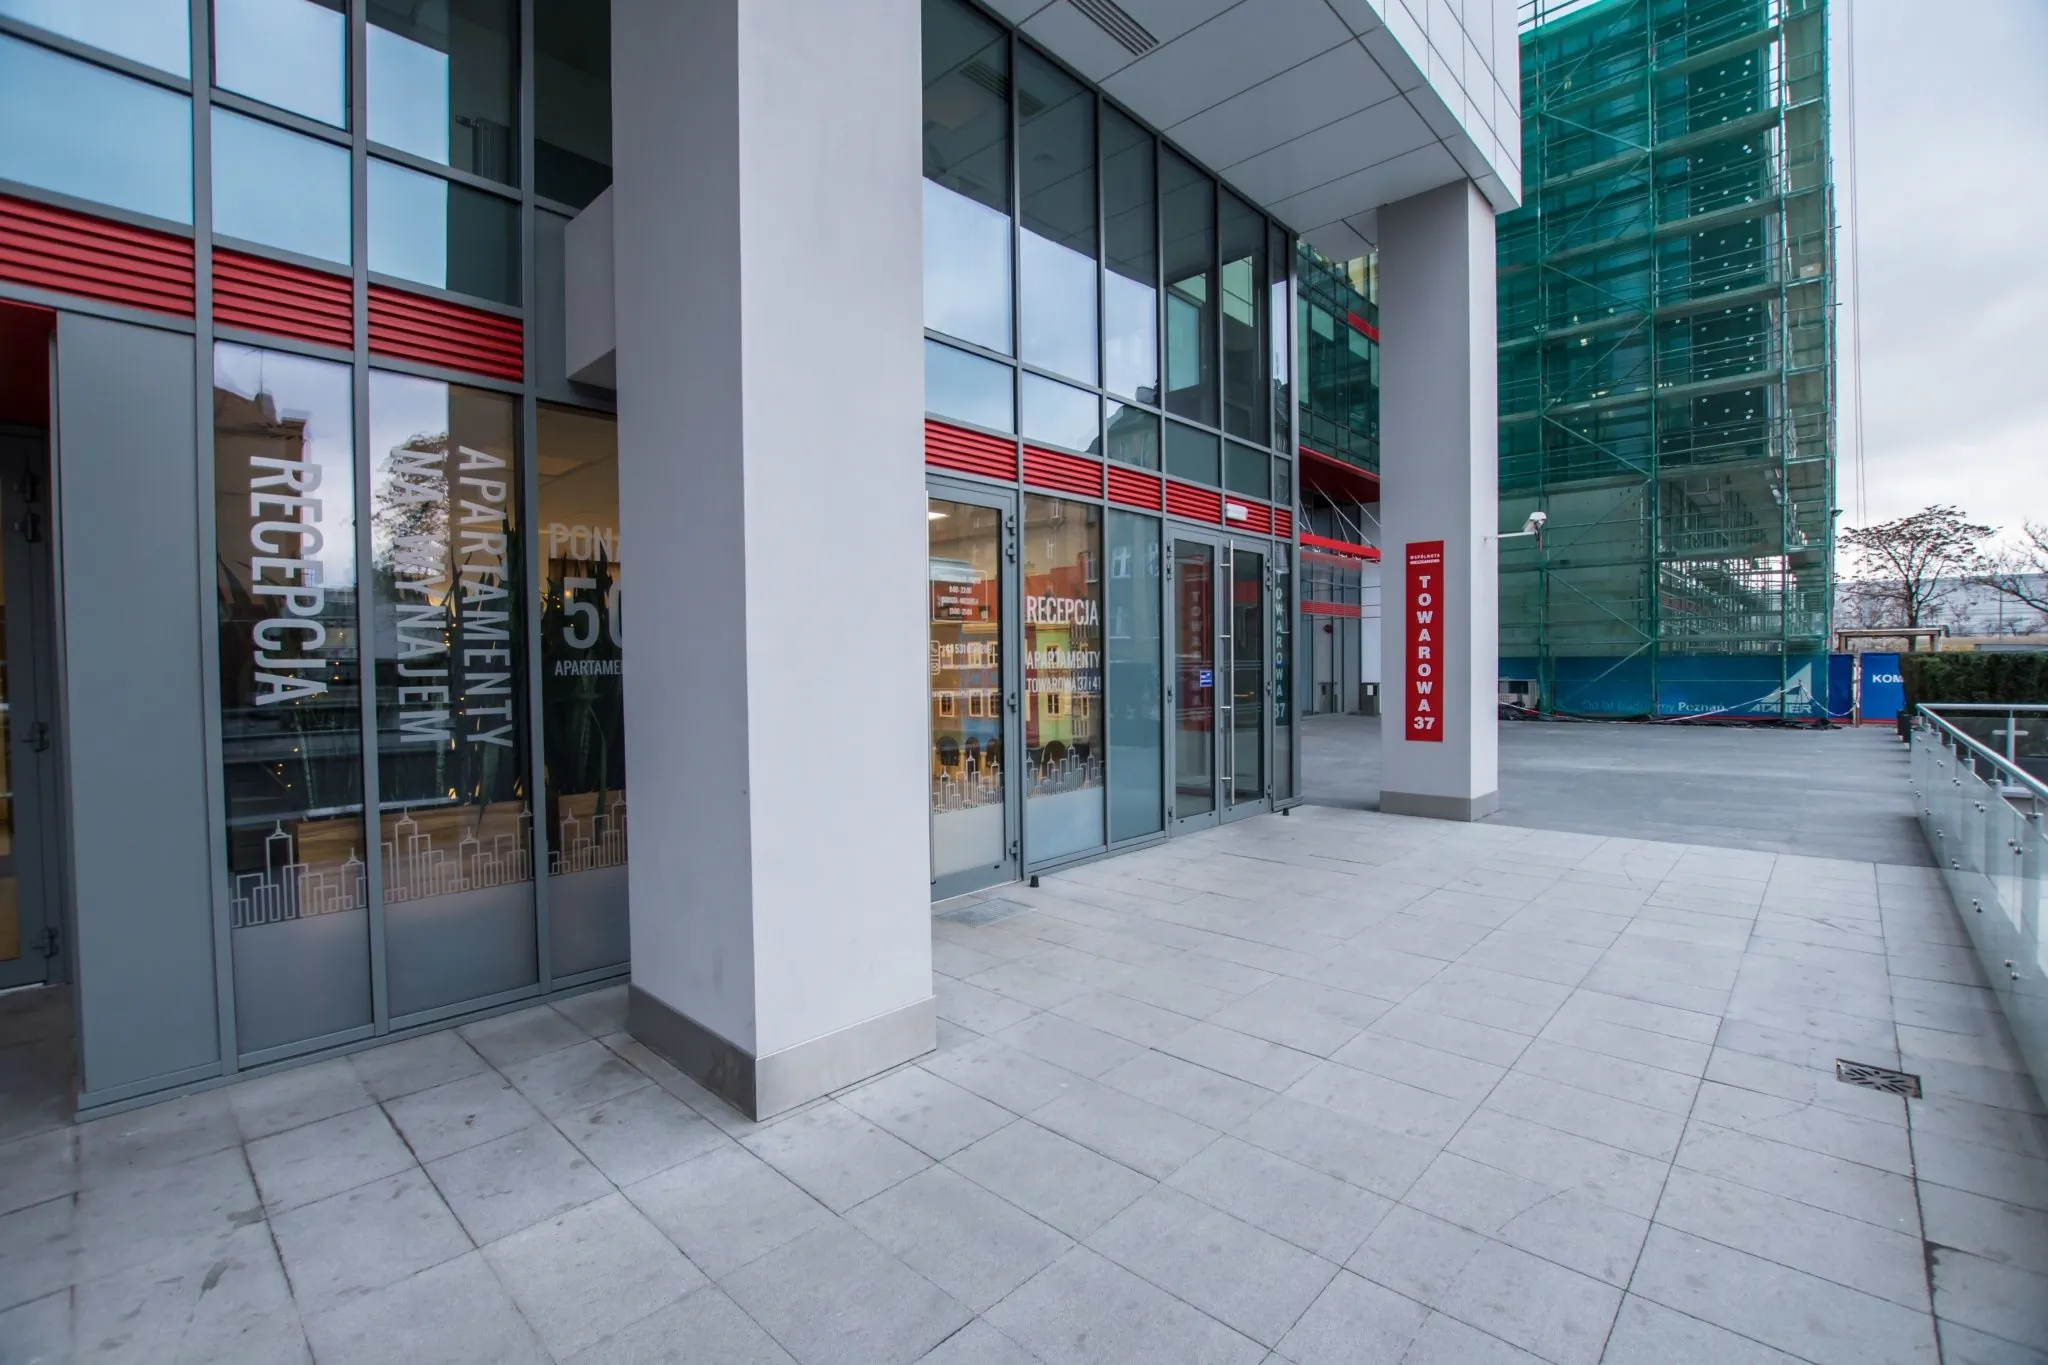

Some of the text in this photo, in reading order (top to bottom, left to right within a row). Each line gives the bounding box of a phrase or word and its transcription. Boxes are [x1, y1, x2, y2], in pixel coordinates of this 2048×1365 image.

[250, 455, 329, 706] RECEPCJA
[548, 522, 621, 563] PON
[394, 448, 451, 743] NA WYNAJEM
[458, 445, 513, 748] APARTAMENTY
[1026, 595, 1099, 626] RECEPCJA
[1275, 571, 1284, 697] TOWAROWA
[1026, 650, 1100, 669] APARTAMENTY
[1026, 676, 1077, 693] TOWAROWA
[1416, 575, 1433, 712] TOWAROWA
[1413, 716, 1436, 730] 37
